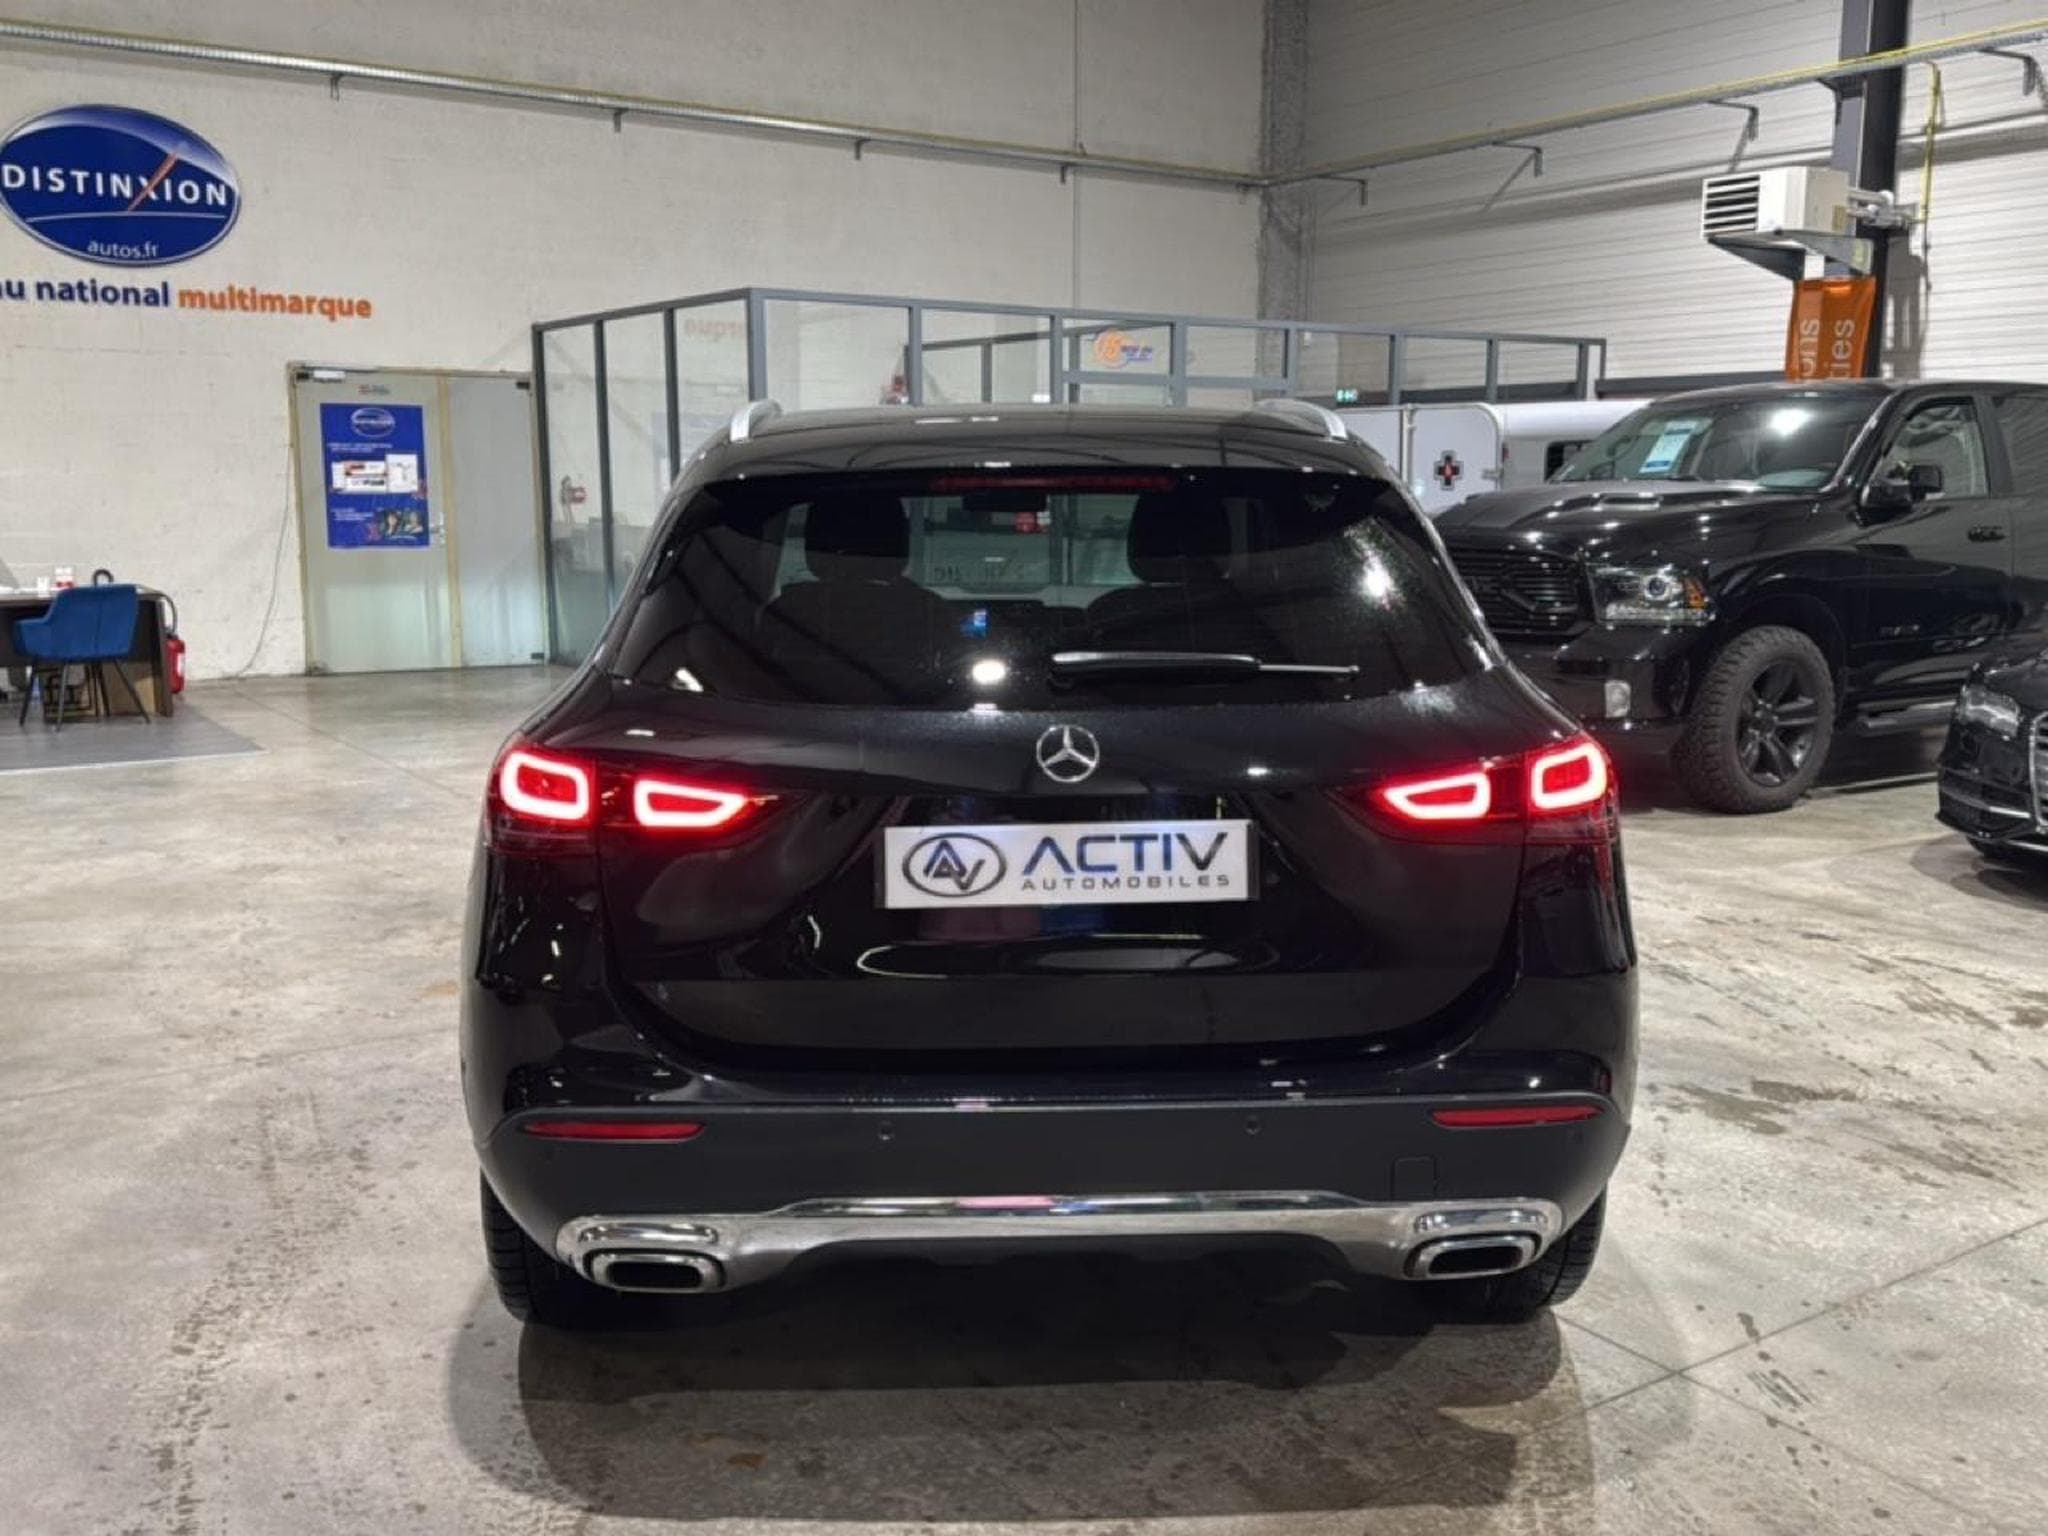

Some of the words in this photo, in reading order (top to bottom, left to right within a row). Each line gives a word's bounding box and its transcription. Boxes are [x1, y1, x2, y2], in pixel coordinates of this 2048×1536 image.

[2, 162, 227, 207] DISTINXION
[87, 241, 158, 258] autos.fr
[36, 278, 169, 307] national
[178, 284, 372, 321] multimarque
[1022, 832, 1228, 875] ACTIV
[1021, 874, 1230, 891] AUTOMOBILES
